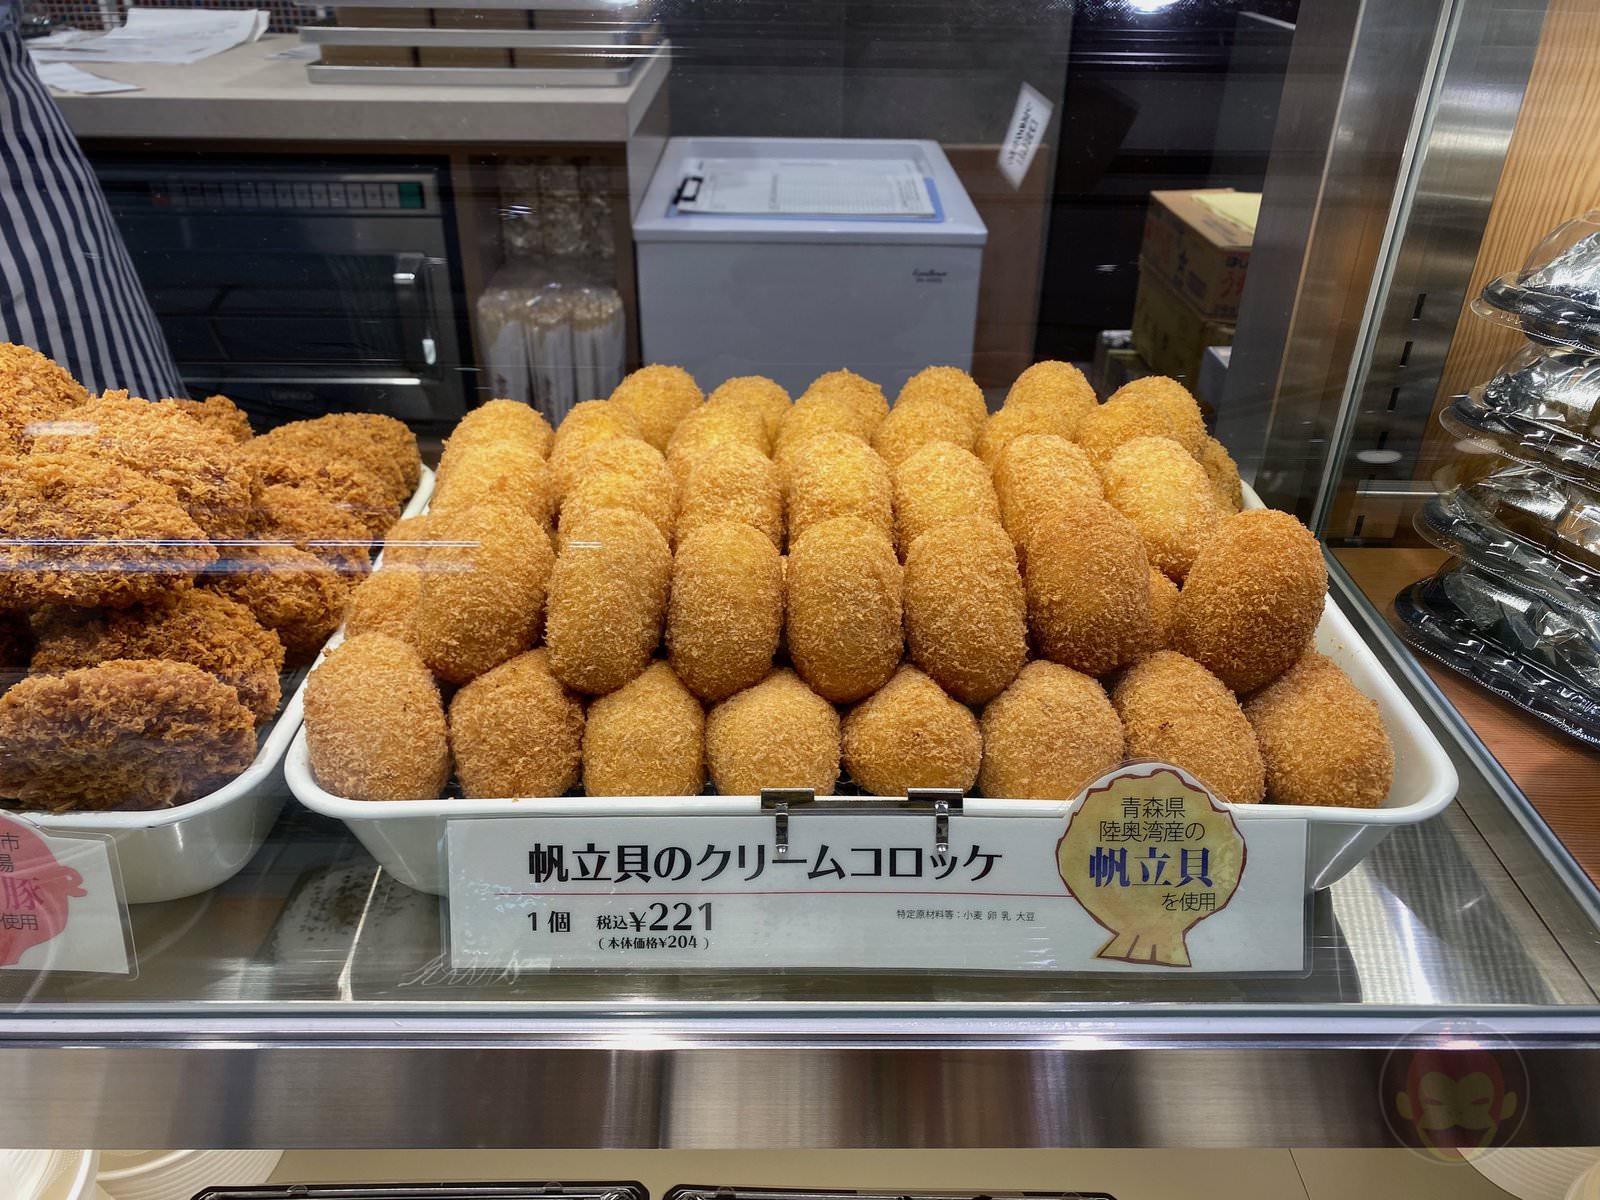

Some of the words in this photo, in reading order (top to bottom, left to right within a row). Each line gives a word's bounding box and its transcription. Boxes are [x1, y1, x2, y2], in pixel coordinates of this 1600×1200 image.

[1120, 796, 1186, 820] 青森県
[1099, 820, 1206, 844] 陸奥湾産の
[527, 841, 1004, 885] 帆立貝のクリームコロッケ
[1088, 846, 1213, 888] 帆立貝
[1161, 891, 1216, 913] を使用
